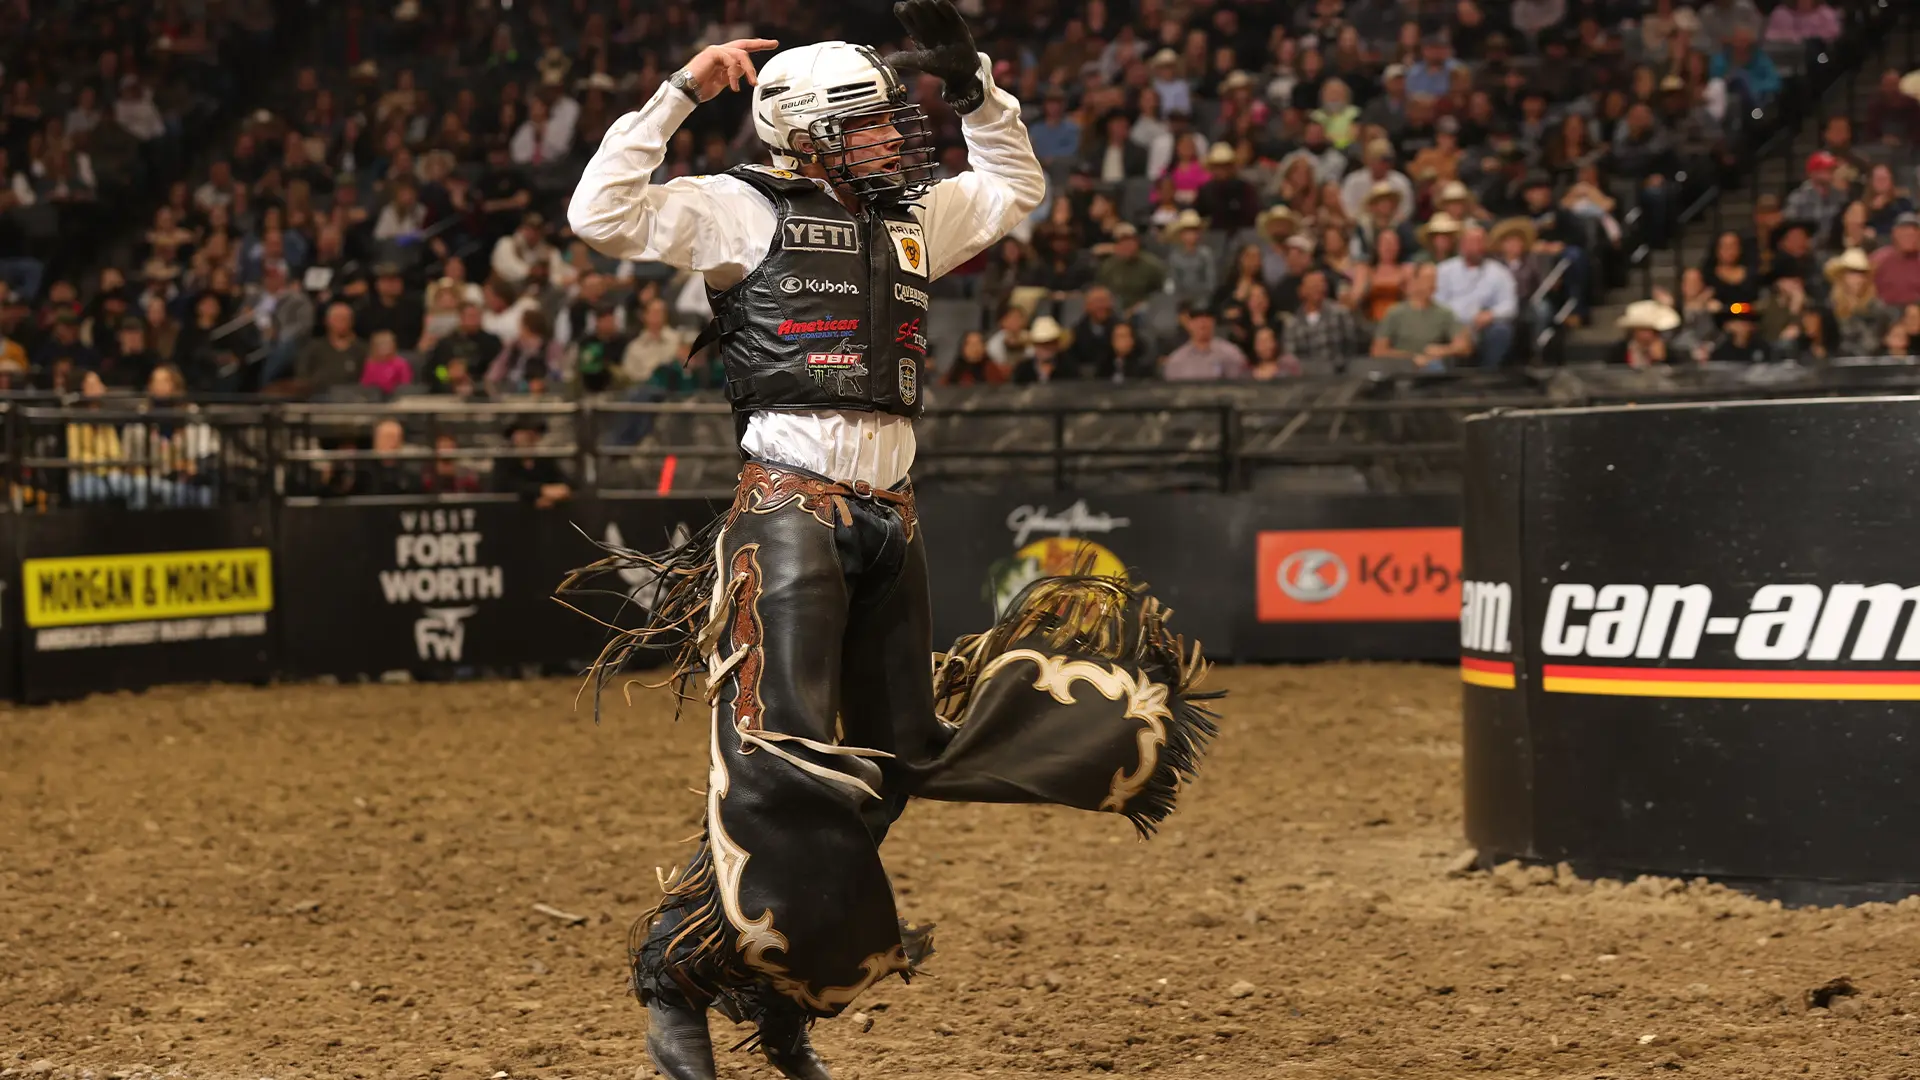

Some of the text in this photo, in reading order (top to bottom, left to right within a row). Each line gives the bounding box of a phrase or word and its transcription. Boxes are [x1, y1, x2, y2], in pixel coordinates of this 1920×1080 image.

[786, 223, 852, 247] YETI
[889, 225, 921, 237] ARIAT
[805, 278, 860, 295] Kubota
[778, 318, 860, 336] American
[809, 354, 859, 364] PBR
[400, 508, 477, 532] VISIT
[396, 532, 482, 567] FORT
[378, 565, 503, 603] WORTH
[1358, 552, 1462, 596] Kub
[38, 560, 259, 613] MORGAN & MORGAN
[1541, 583, 1920, 660] can-am
